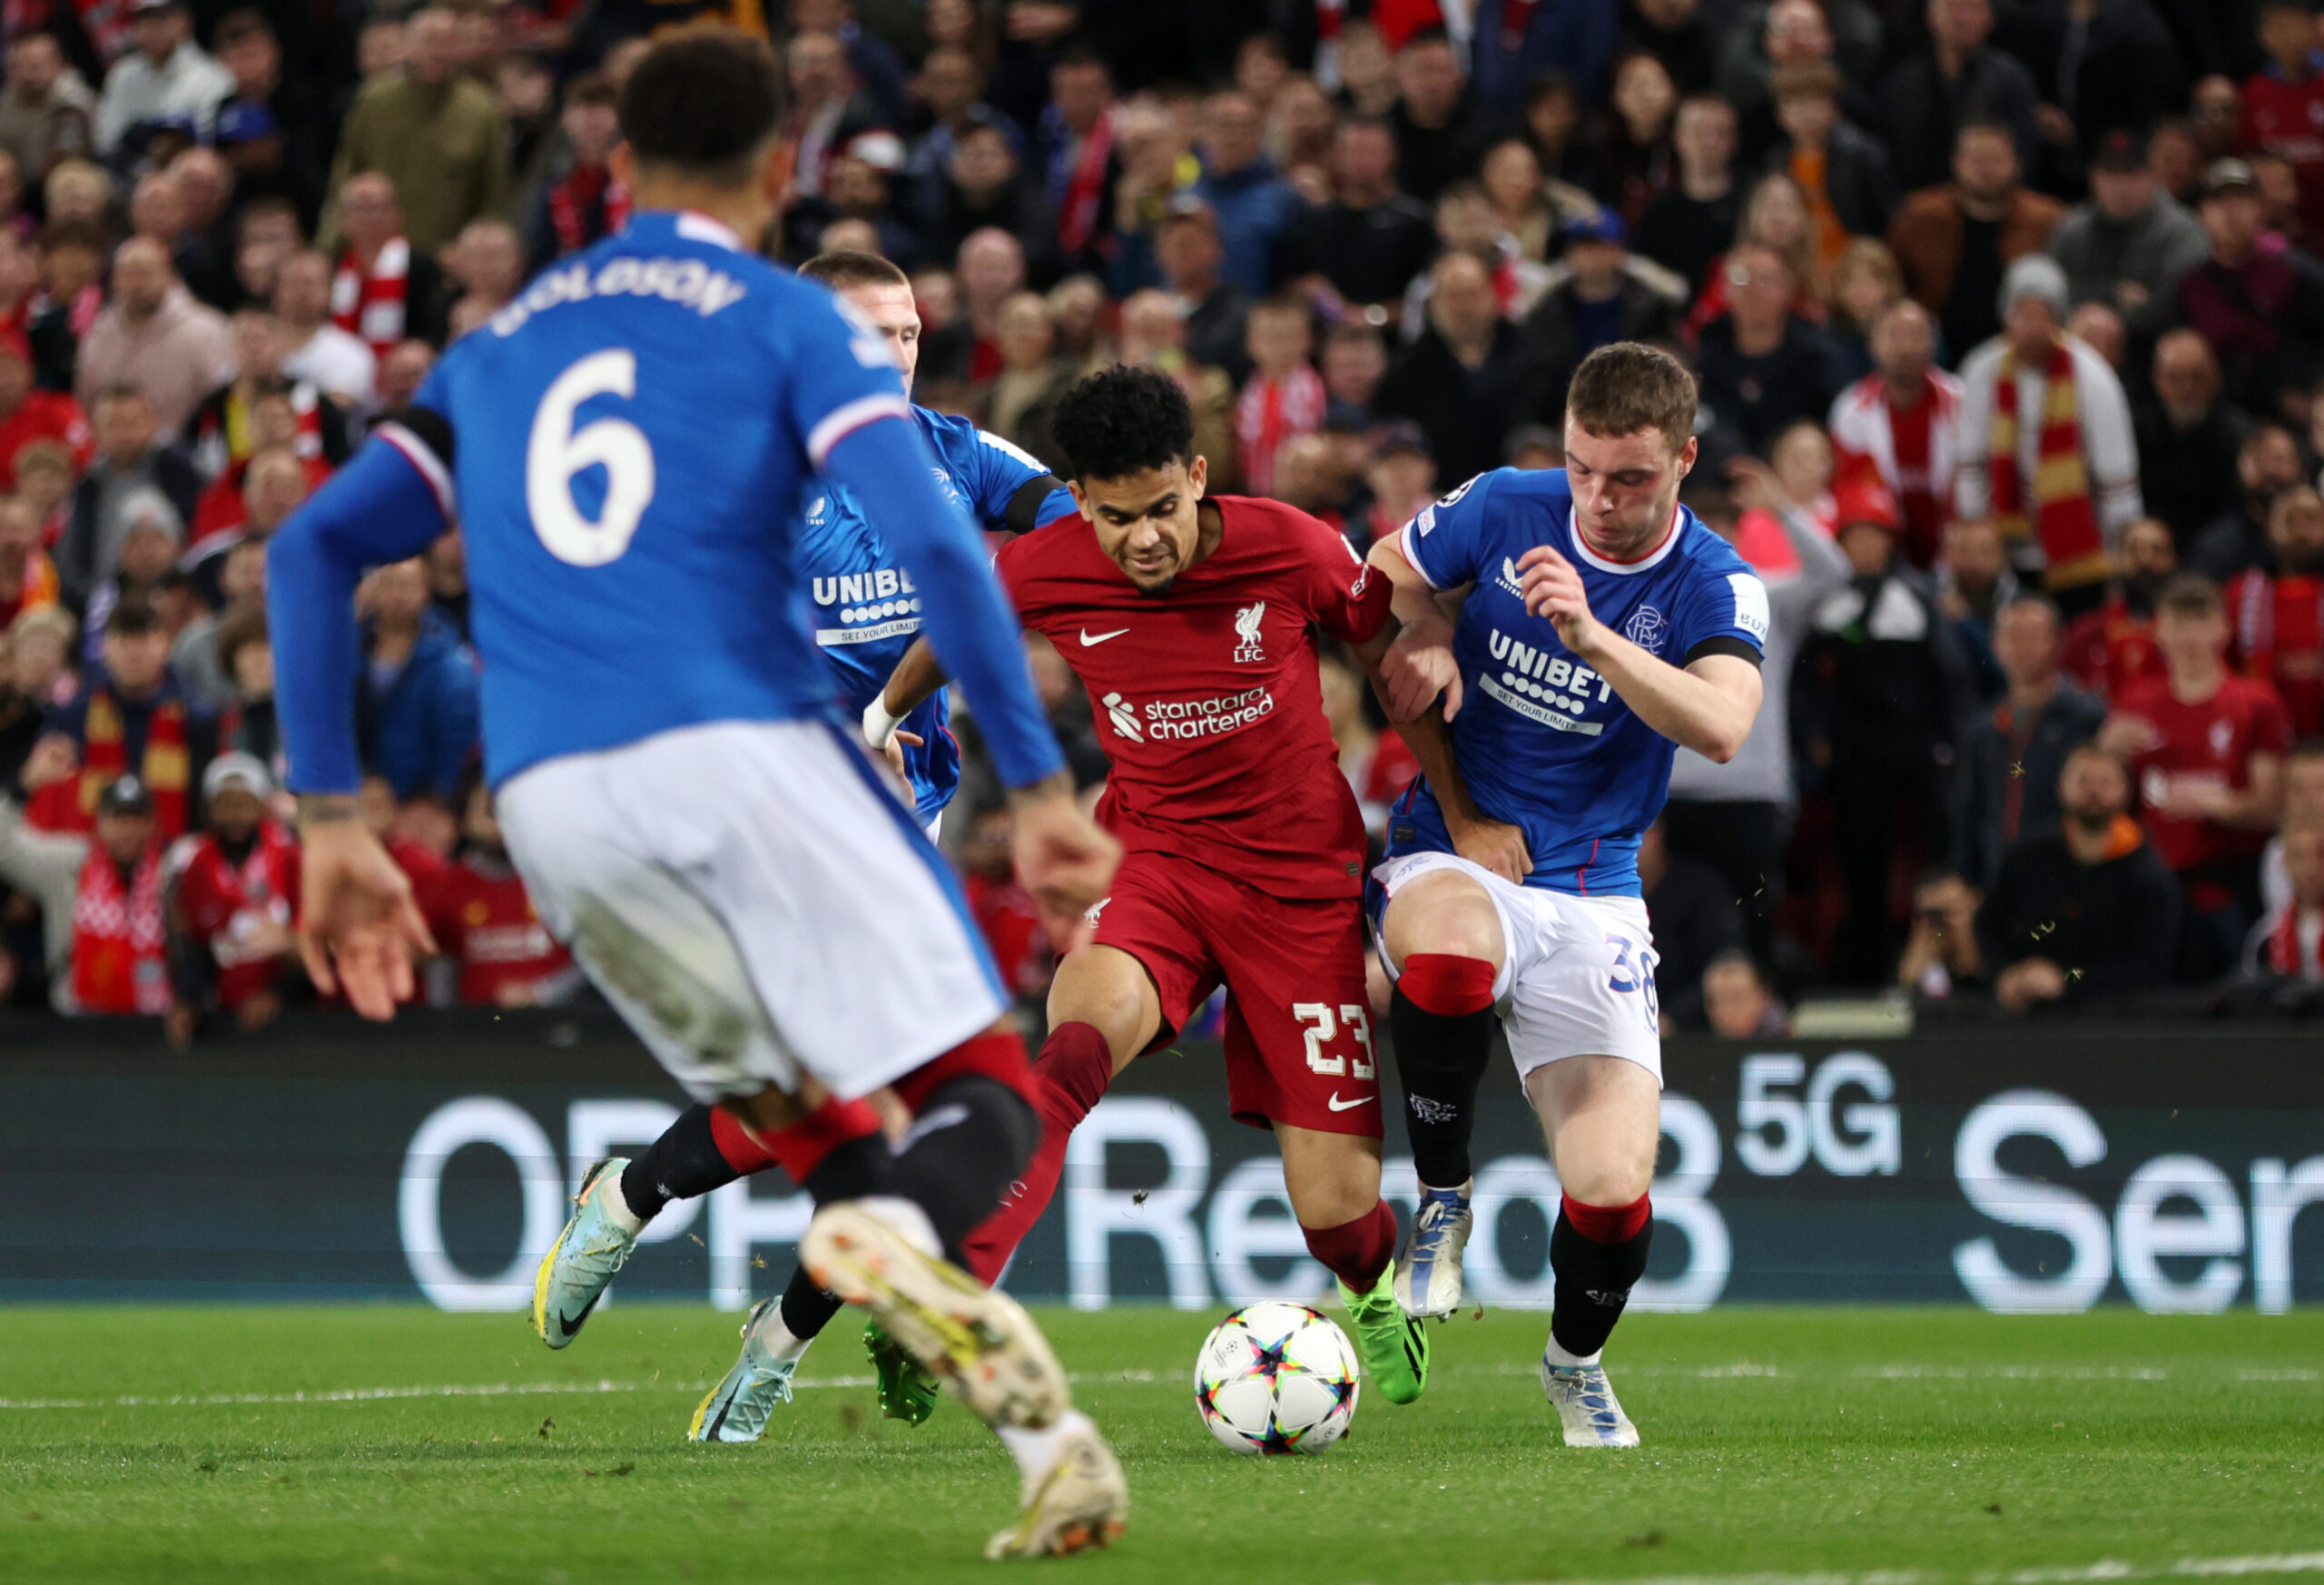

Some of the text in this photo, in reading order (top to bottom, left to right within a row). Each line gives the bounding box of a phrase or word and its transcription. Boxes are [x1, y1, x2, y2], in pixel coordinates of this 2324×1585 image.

[526, 347, 655, 567] 6
[842, 621, 921, 641] SET YOUR LIMIT
[1489, 628, 1612, 704] UNIBET
[1145, 685, 1265, 721] standard
[1149, 694, 1275, 740] chartered
[1497, 690, 1577, 730] SET YOUR LIMITS
[1293, 1002, 1375, 1081] 23
[1735, 1050, 1902, 1176] 5G
